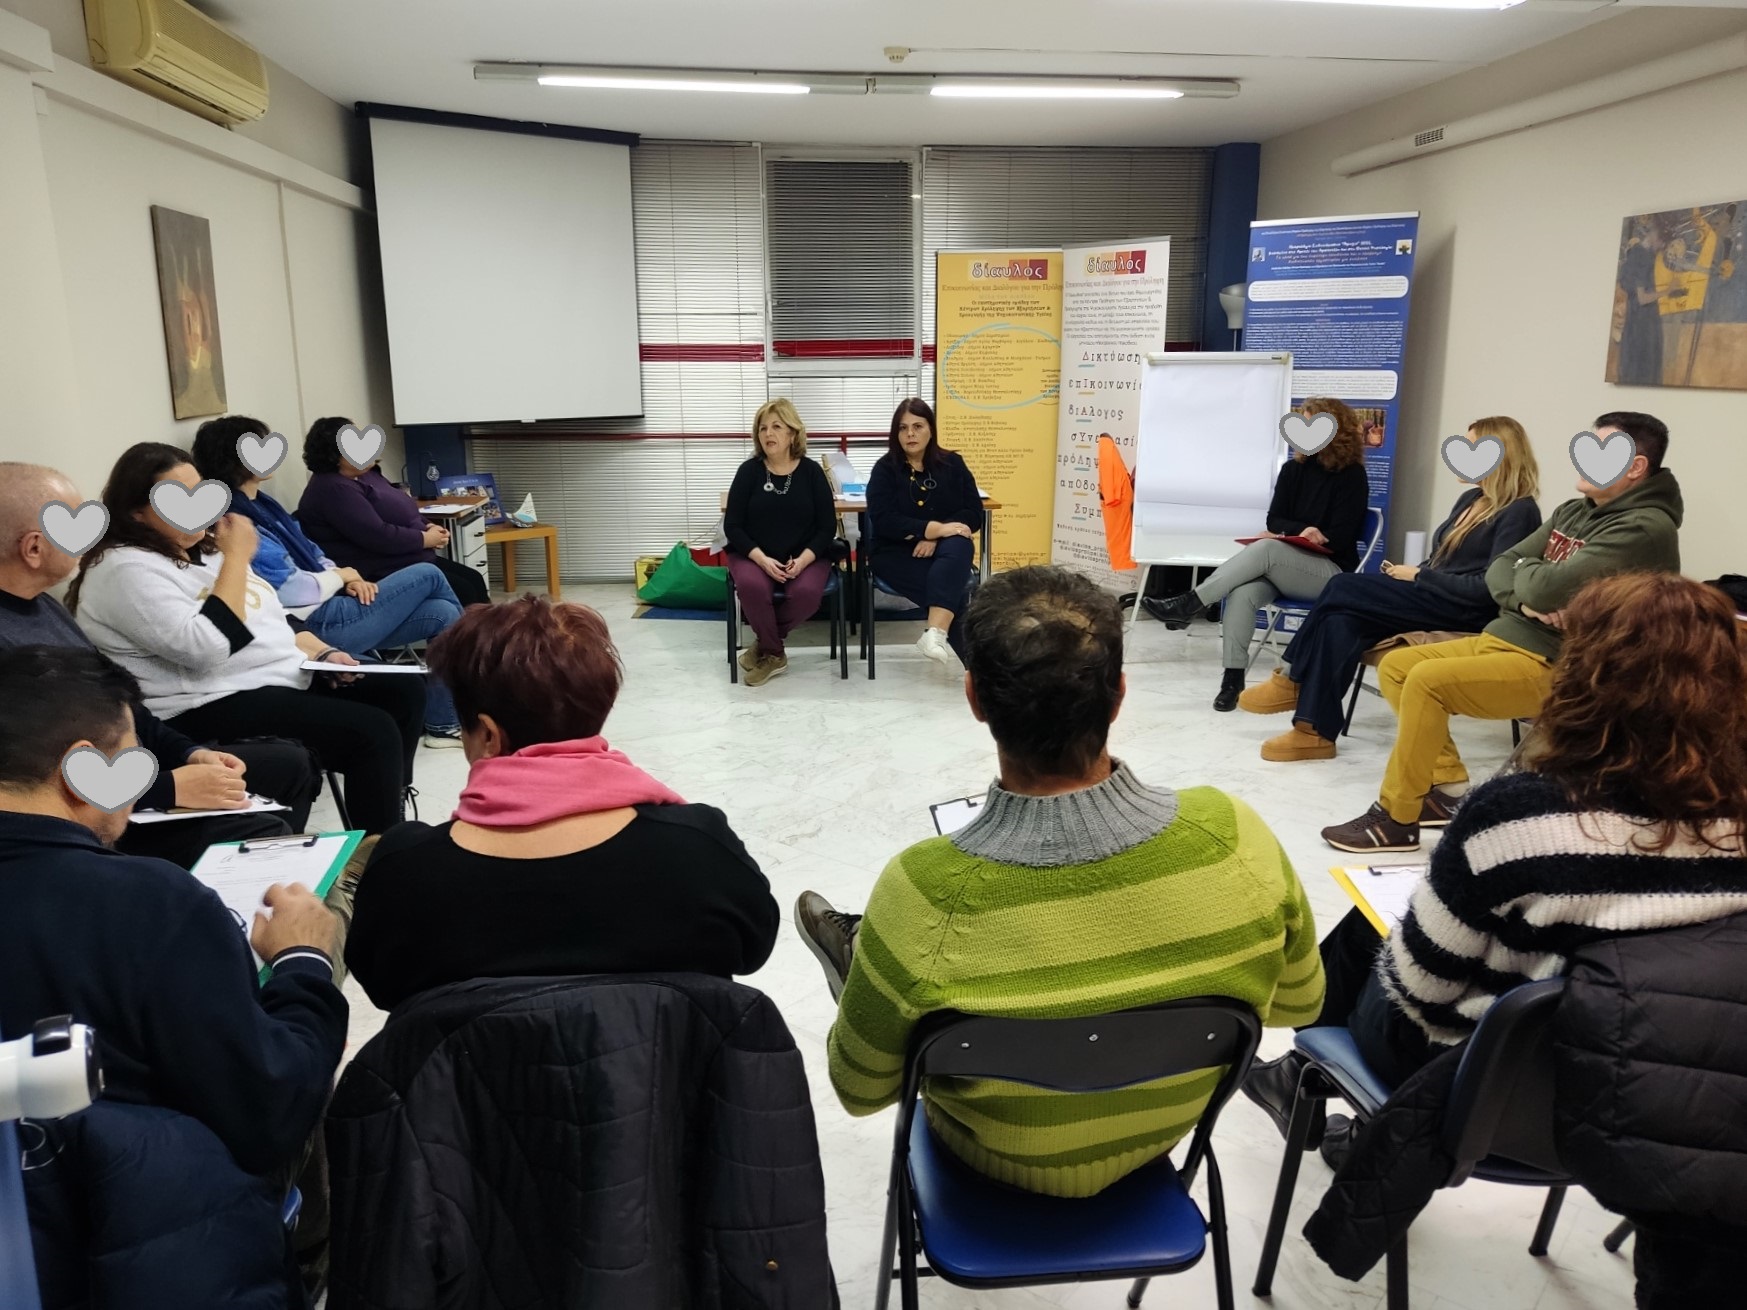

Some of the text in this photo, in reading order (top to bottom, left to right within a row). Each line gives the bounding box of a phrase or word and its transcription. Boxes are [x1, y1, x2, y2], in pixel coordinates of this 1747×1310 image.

[972, 262, 1043, 278] δίαυλος
[1087, 256, 1141, 273] δίαυλος
[1082, 350, 1141, 365] Δικτύωση
[1071, 432, 1138, 447] σΥνεασί
[1057, 453, 1099, 469] πρόΛηψ
